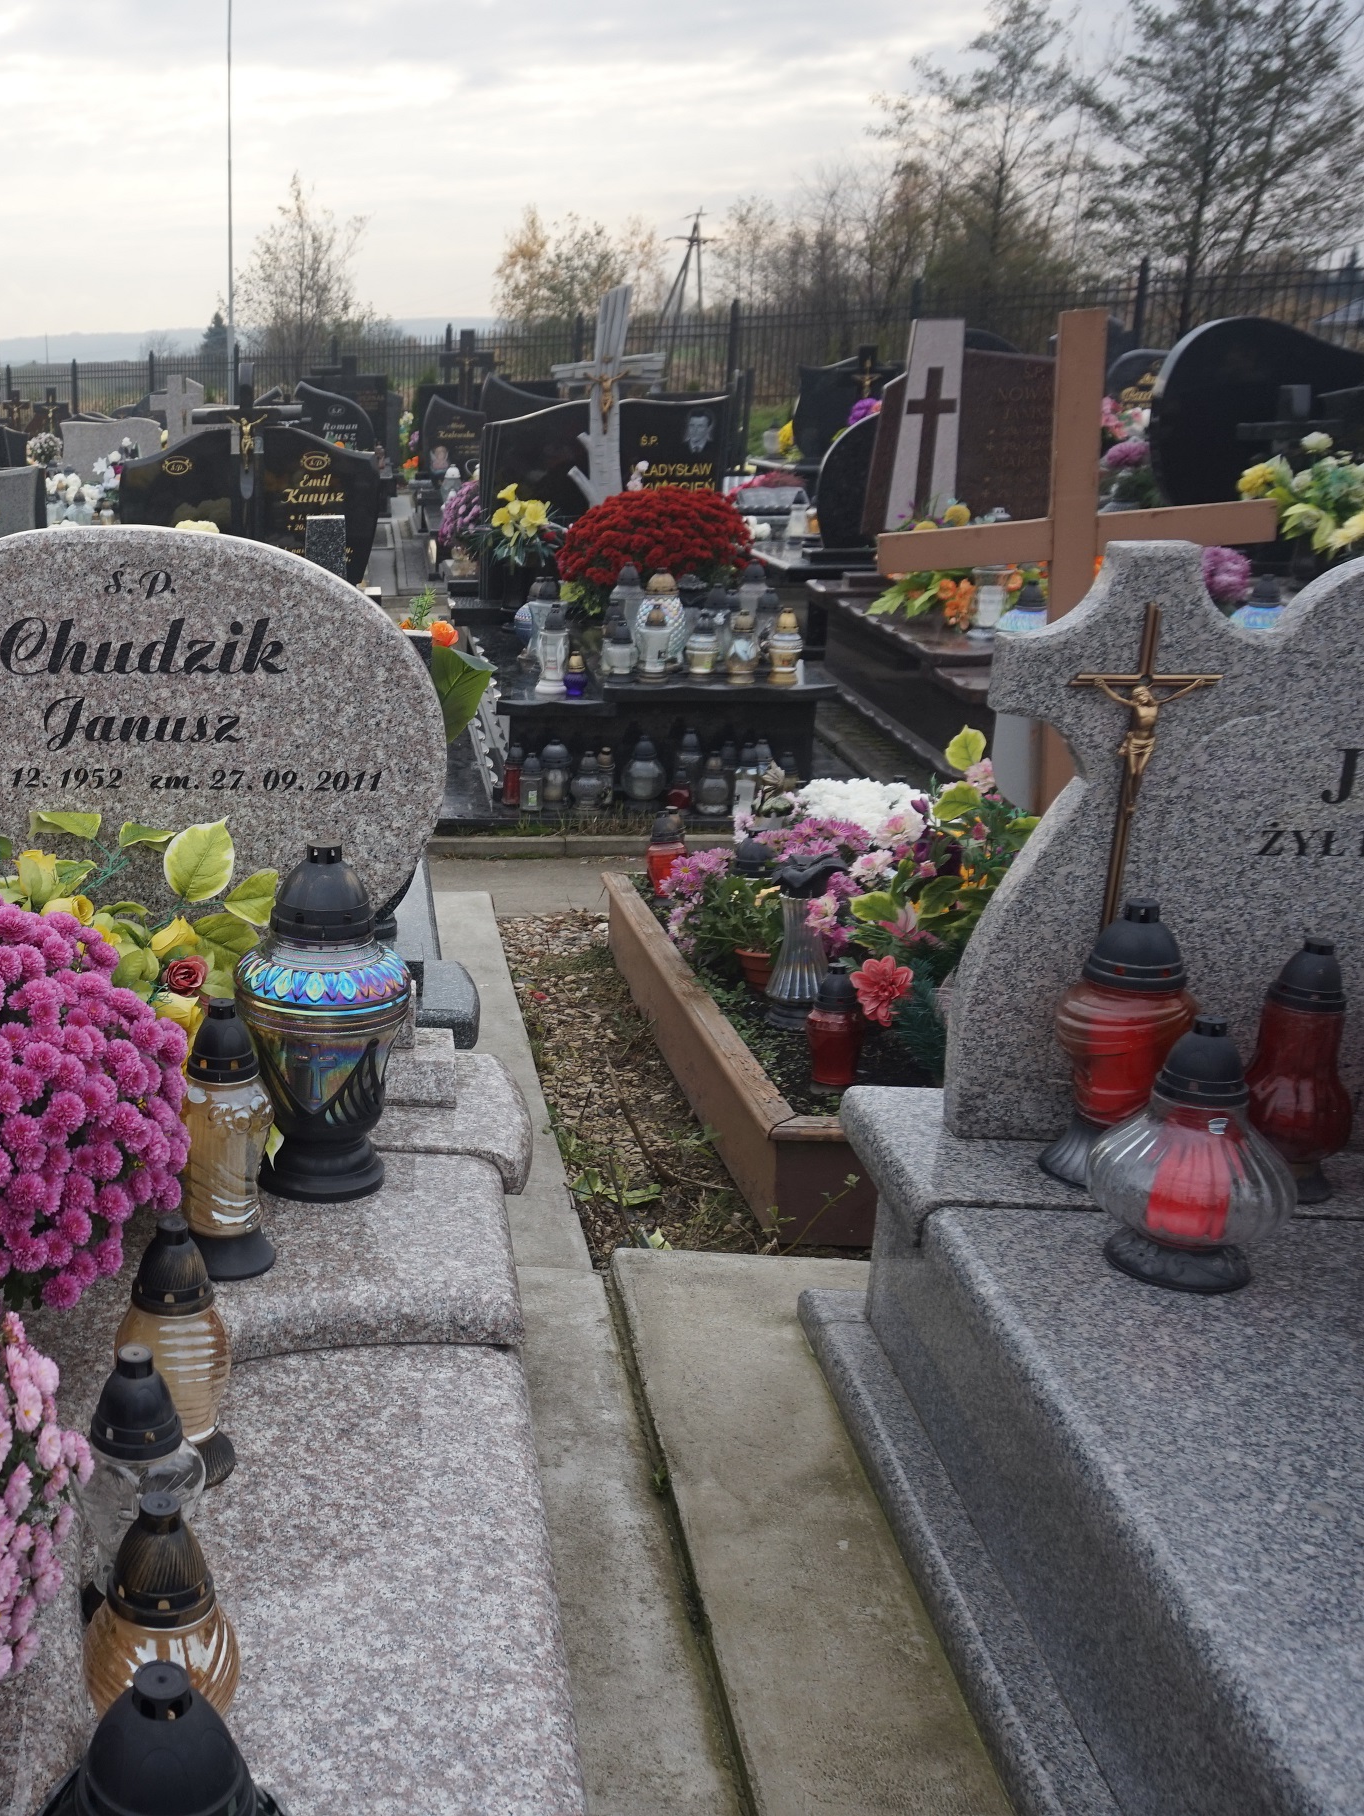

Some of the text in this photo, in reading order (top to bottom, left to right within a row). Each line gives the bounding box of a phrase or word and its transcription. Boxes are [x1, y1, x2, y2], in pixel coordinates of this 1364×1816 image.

[997, 387, 1052, 402] NOWA
[322, 422, 358, 431] Roman
[299, 473, 332, 488] Emil
[280, 488, 345, 506] Kunysz
[0, 616, 287, 677] Chudzik
[43, 695, 243, 752] Janusz
[11, 767, 49, 789] 12.
[59, 767, 124, 789] 1952
[149, 774, 200, 790] zm.
[208, 769, 253, 791] 27.
[262, 770, 305, 792] 09.
[313, 770, 384, 792] 2011
